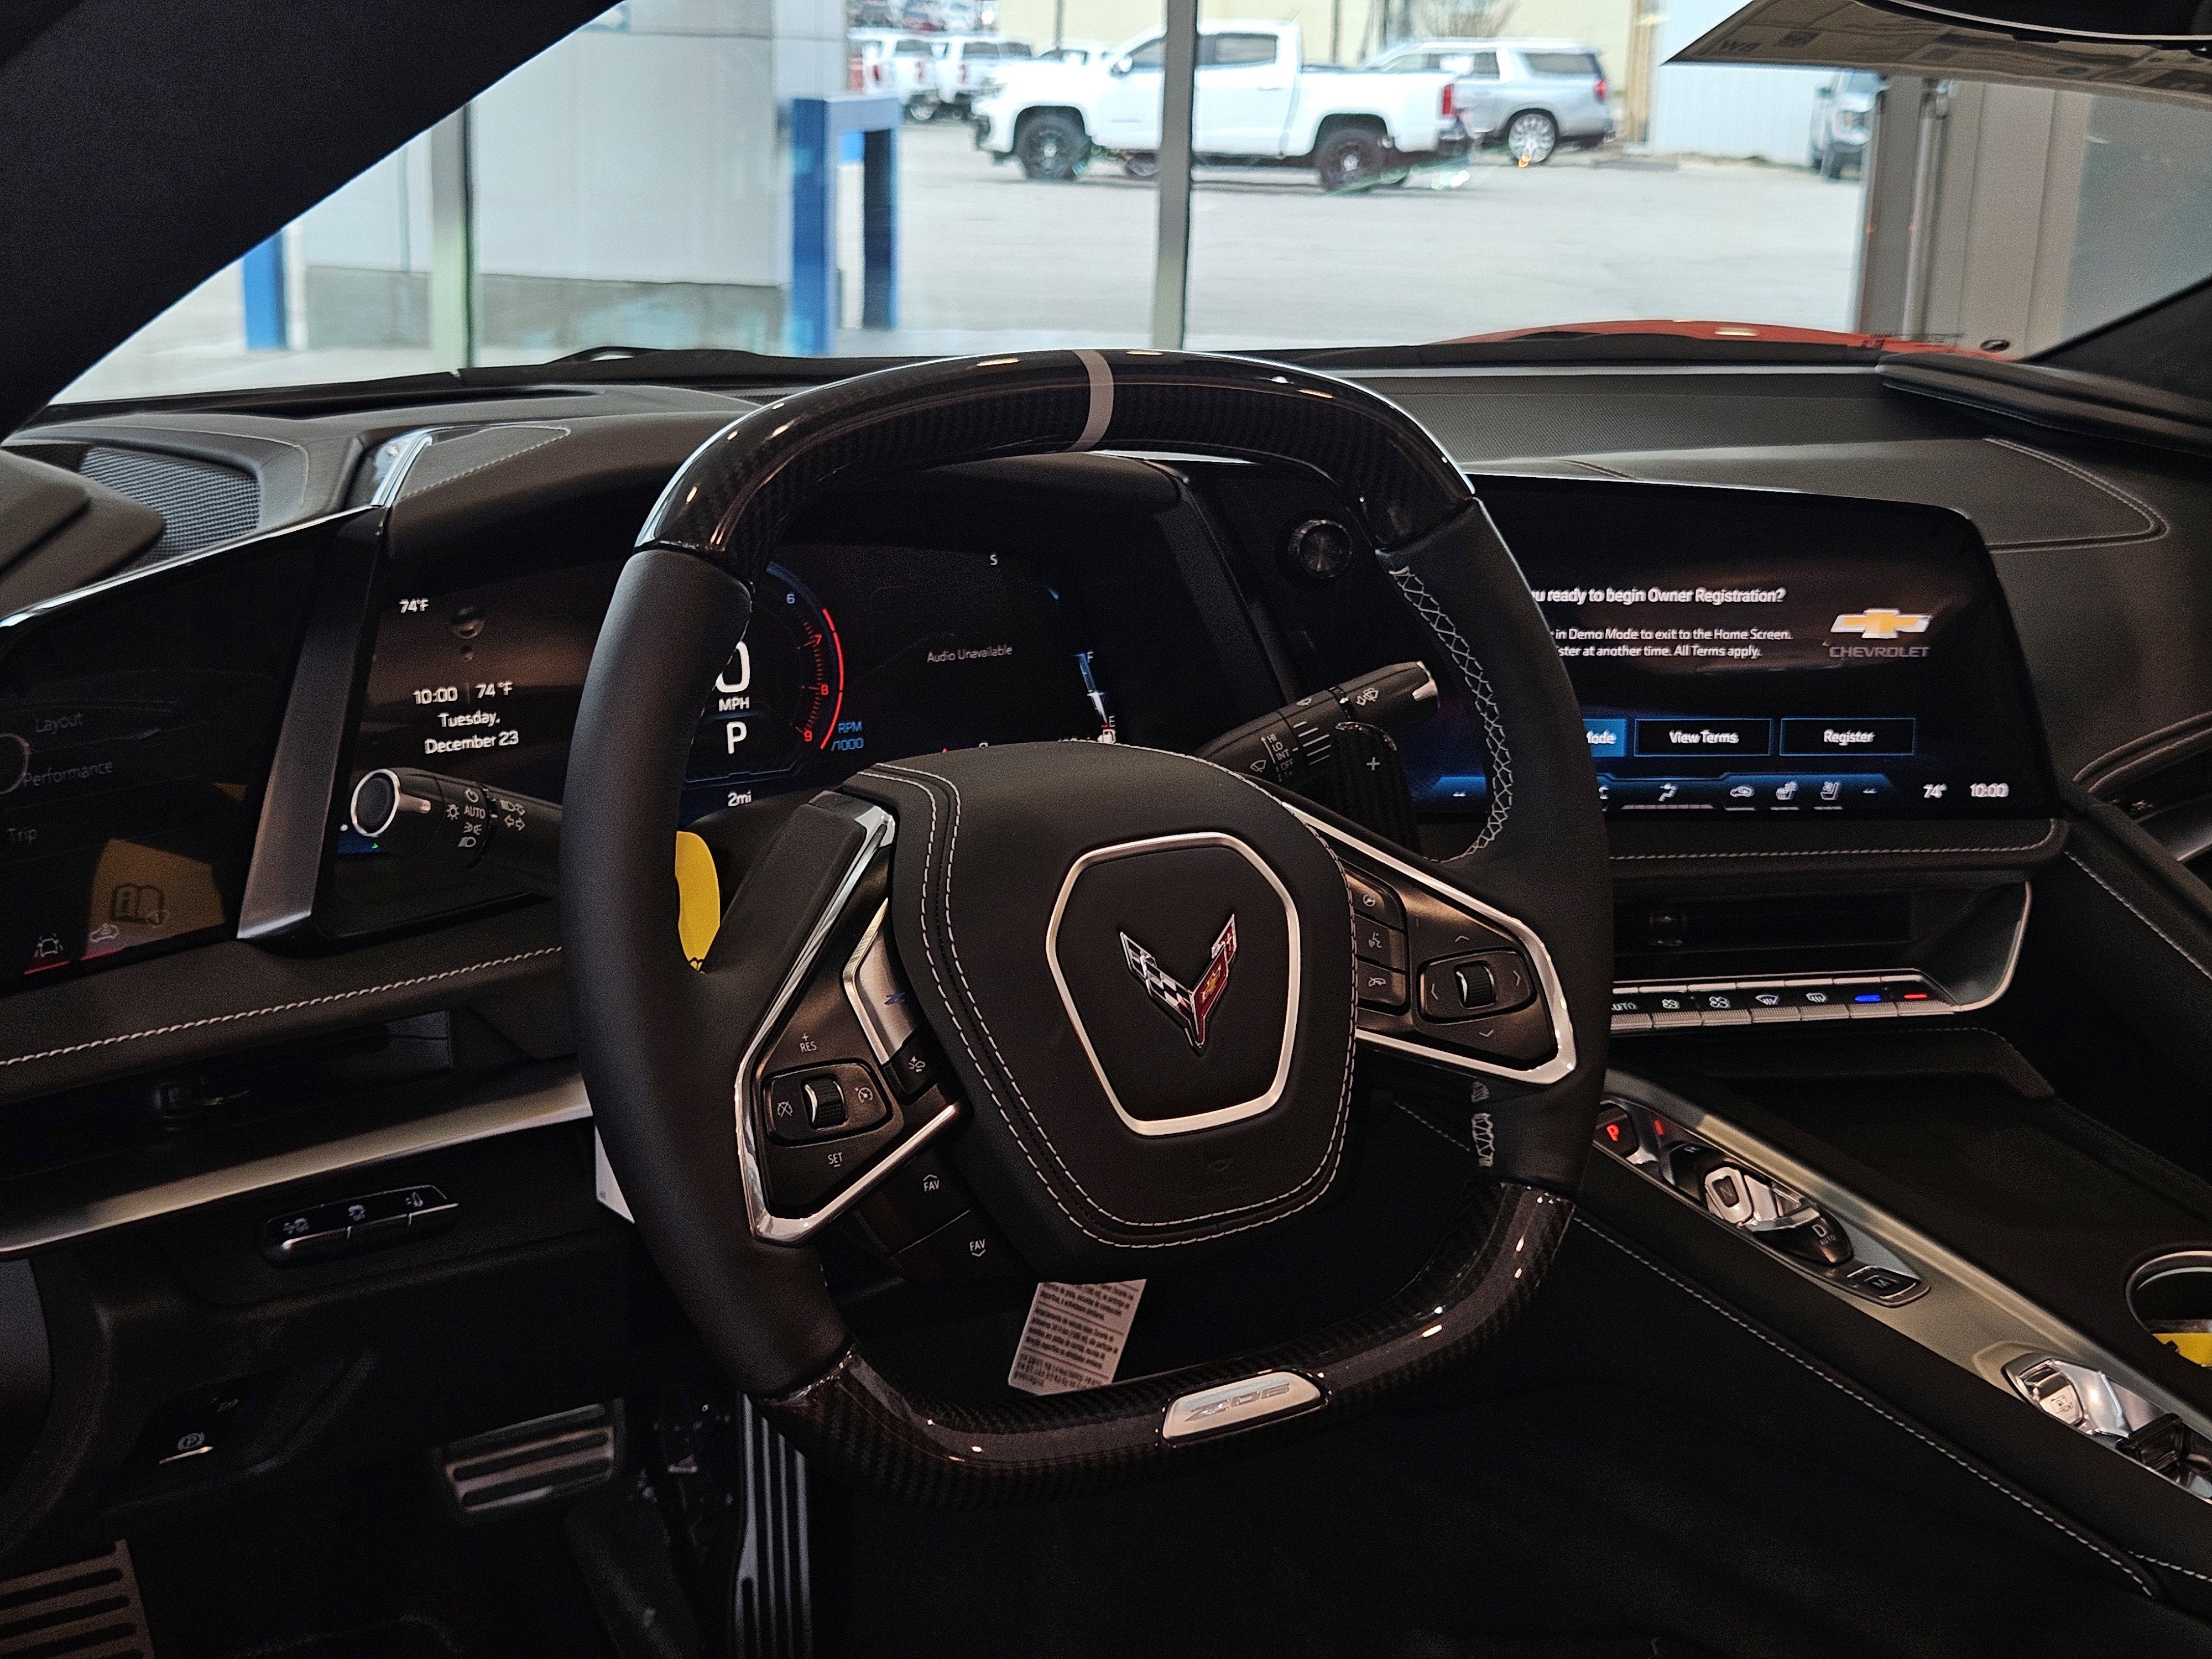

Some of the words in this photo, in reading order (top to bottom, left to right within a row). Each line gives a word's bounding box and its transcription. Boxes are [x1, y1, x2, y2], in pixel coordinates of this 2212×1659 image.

[989, 554, 998, 566] S
[786, 592, 795, 604] 6
[1547, 589, 1587, 605] ready
[1589, 588, 1604, 601] to
[1606, 587, 1646, 605] begin
[1647, 588, 1694, 602] Owner
[1695, 587, 1786, 606] Registration?
[1555, 628, 1567, 639] in
[1568, 628, 1603, 639] Demo
[1605, 628, 1640, 640] Mode
[1640, 629, 1652, 639] to
[1655, 628, 1677, 639] exit
[1677, 629, 1691, 639] to
[1693, 628, 1713, 639] the
[1714, 628, 1750, 639] Home
[1750, 628, 1793, 640] Screen.
[927, 651, 956, 664] Audio
[957, 644, 1013, 661] Unavailable
[1558, 646, 1582, 656] ster
[1582, 646, 1595, 656] at
[1596, 645, 1643, 656] another
[1644, 645, 1673, 656] time.
[1673, 644, 1690, 656] All
[1691, 645, 1726, 656] Terms
[1726, 646, 1762, 659] apply.
[1829, 646, 1930, 658] CHEVROLET
[413, 686, 458, 705] 10:00
[820, 683, 829, 696] 8
[718, 696, 750, 712] MPH
[35, 712, 84, 734] Layout
[837, 721, 863, 733] RPM
[1109, 716, 1115, 728] E
[424, 734, 497, 753] December
[498, 729, 519, 746] 23
[726, 721, 747, 754] P
[803, 729, 812, 742] 9
[1669, 730, 1700, 744] View
[1700, 731, 1740, 744] Terms
[1823, 729, 1875, 745] Register
[1271, 742, 1283, 752] LO
[23, 760, 114, 786] Performance
[1969, 783, 2009, 797] 10:00
[727, 789, 752, 807] 2mi
[463, 805, 486, 820] AUTO
[6, 827, 38, 843] Trip
[800, 1040, 817, 1052] RES
[1606, 1124, 1620, 1142] P
[828, 1152, 843, 1164] SET
[924, 1180, 940, 1192] FAV
[1812, 1224, 1827, 1238] D
[969, 1239, 985, 1251] FAV
